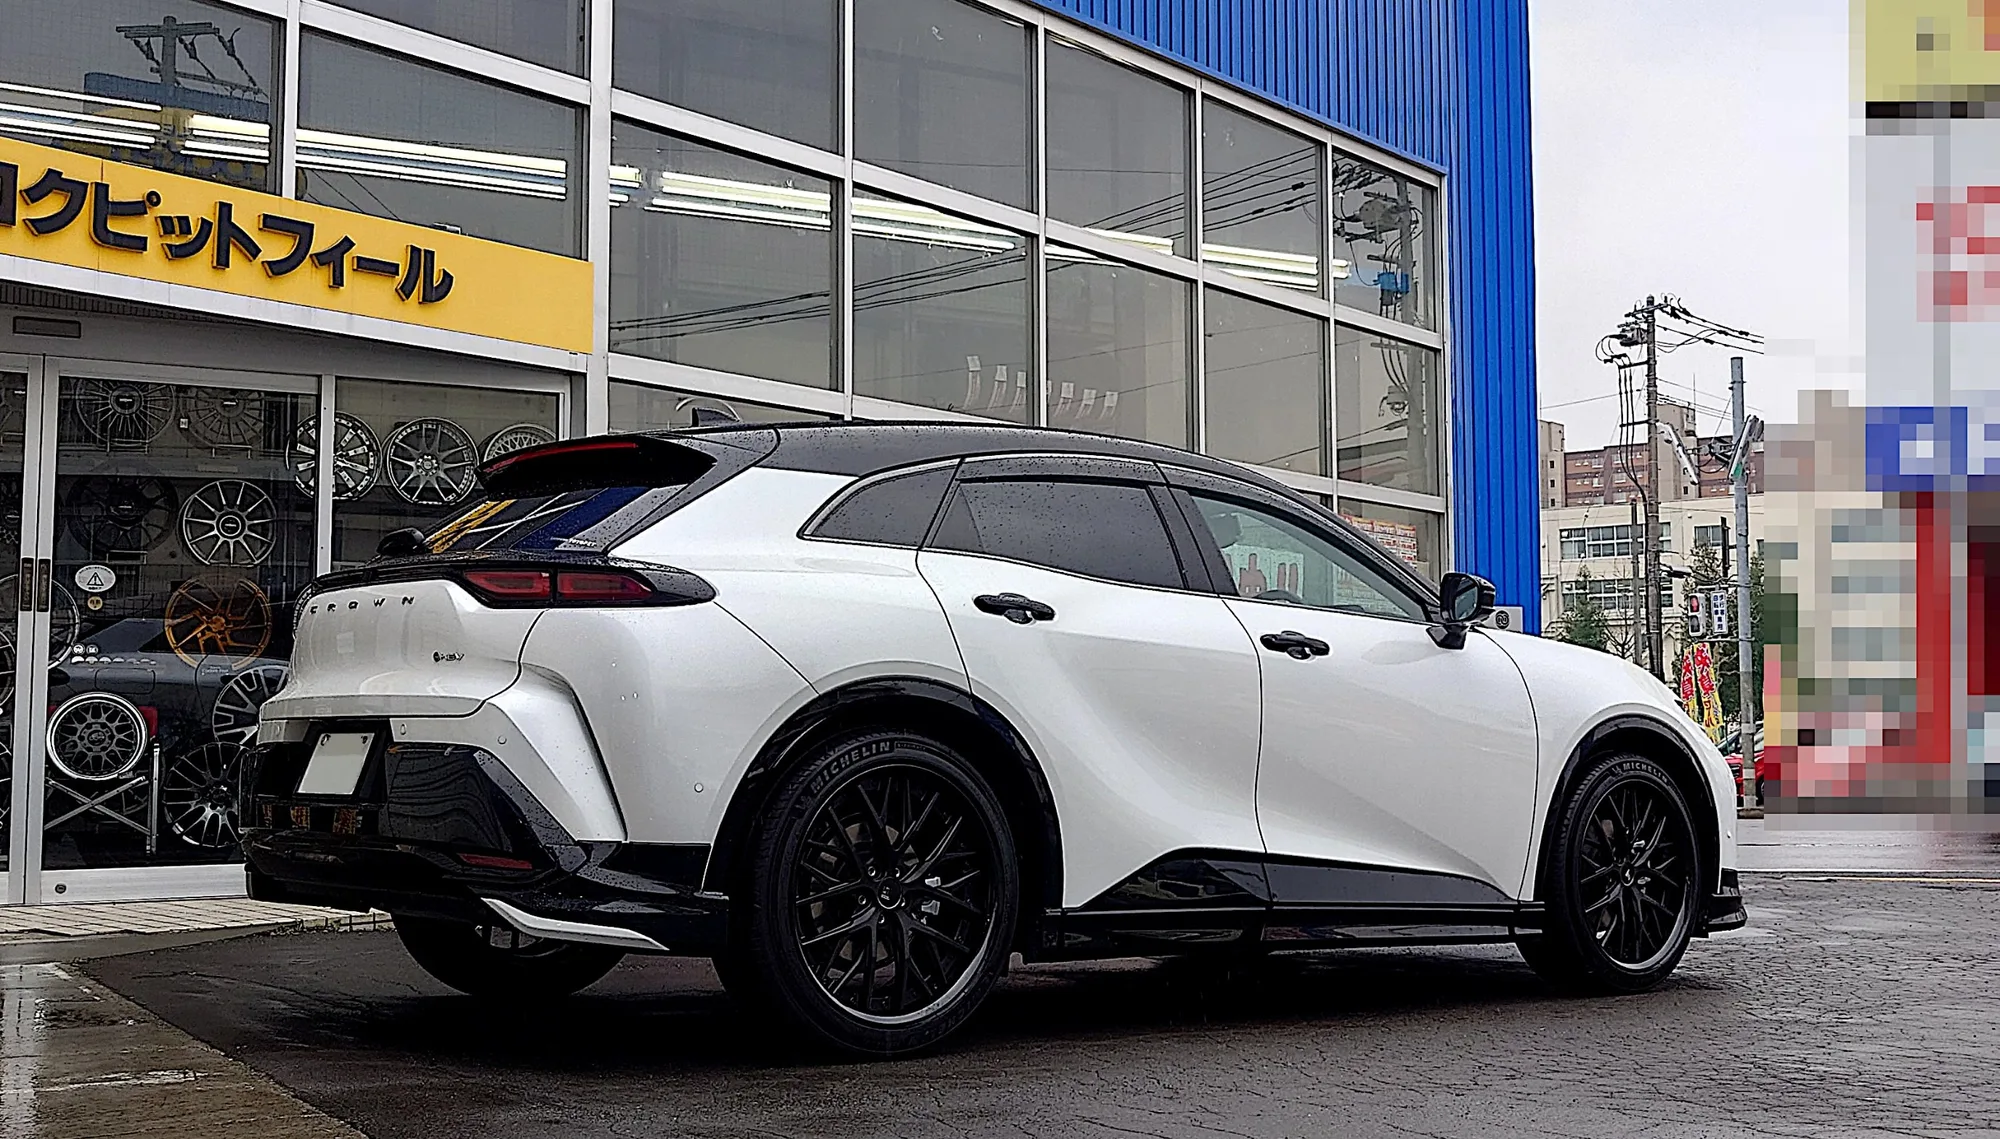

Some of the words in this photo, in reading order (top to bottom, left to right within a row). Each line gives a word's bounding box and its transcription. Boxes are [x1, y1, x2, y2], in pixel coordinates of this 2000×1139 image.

[310, 596, 414, 614] CROWN
[810, 741, 890, 794] MICHELIN
[1622, 762, 1667, 783] MICHELIN
